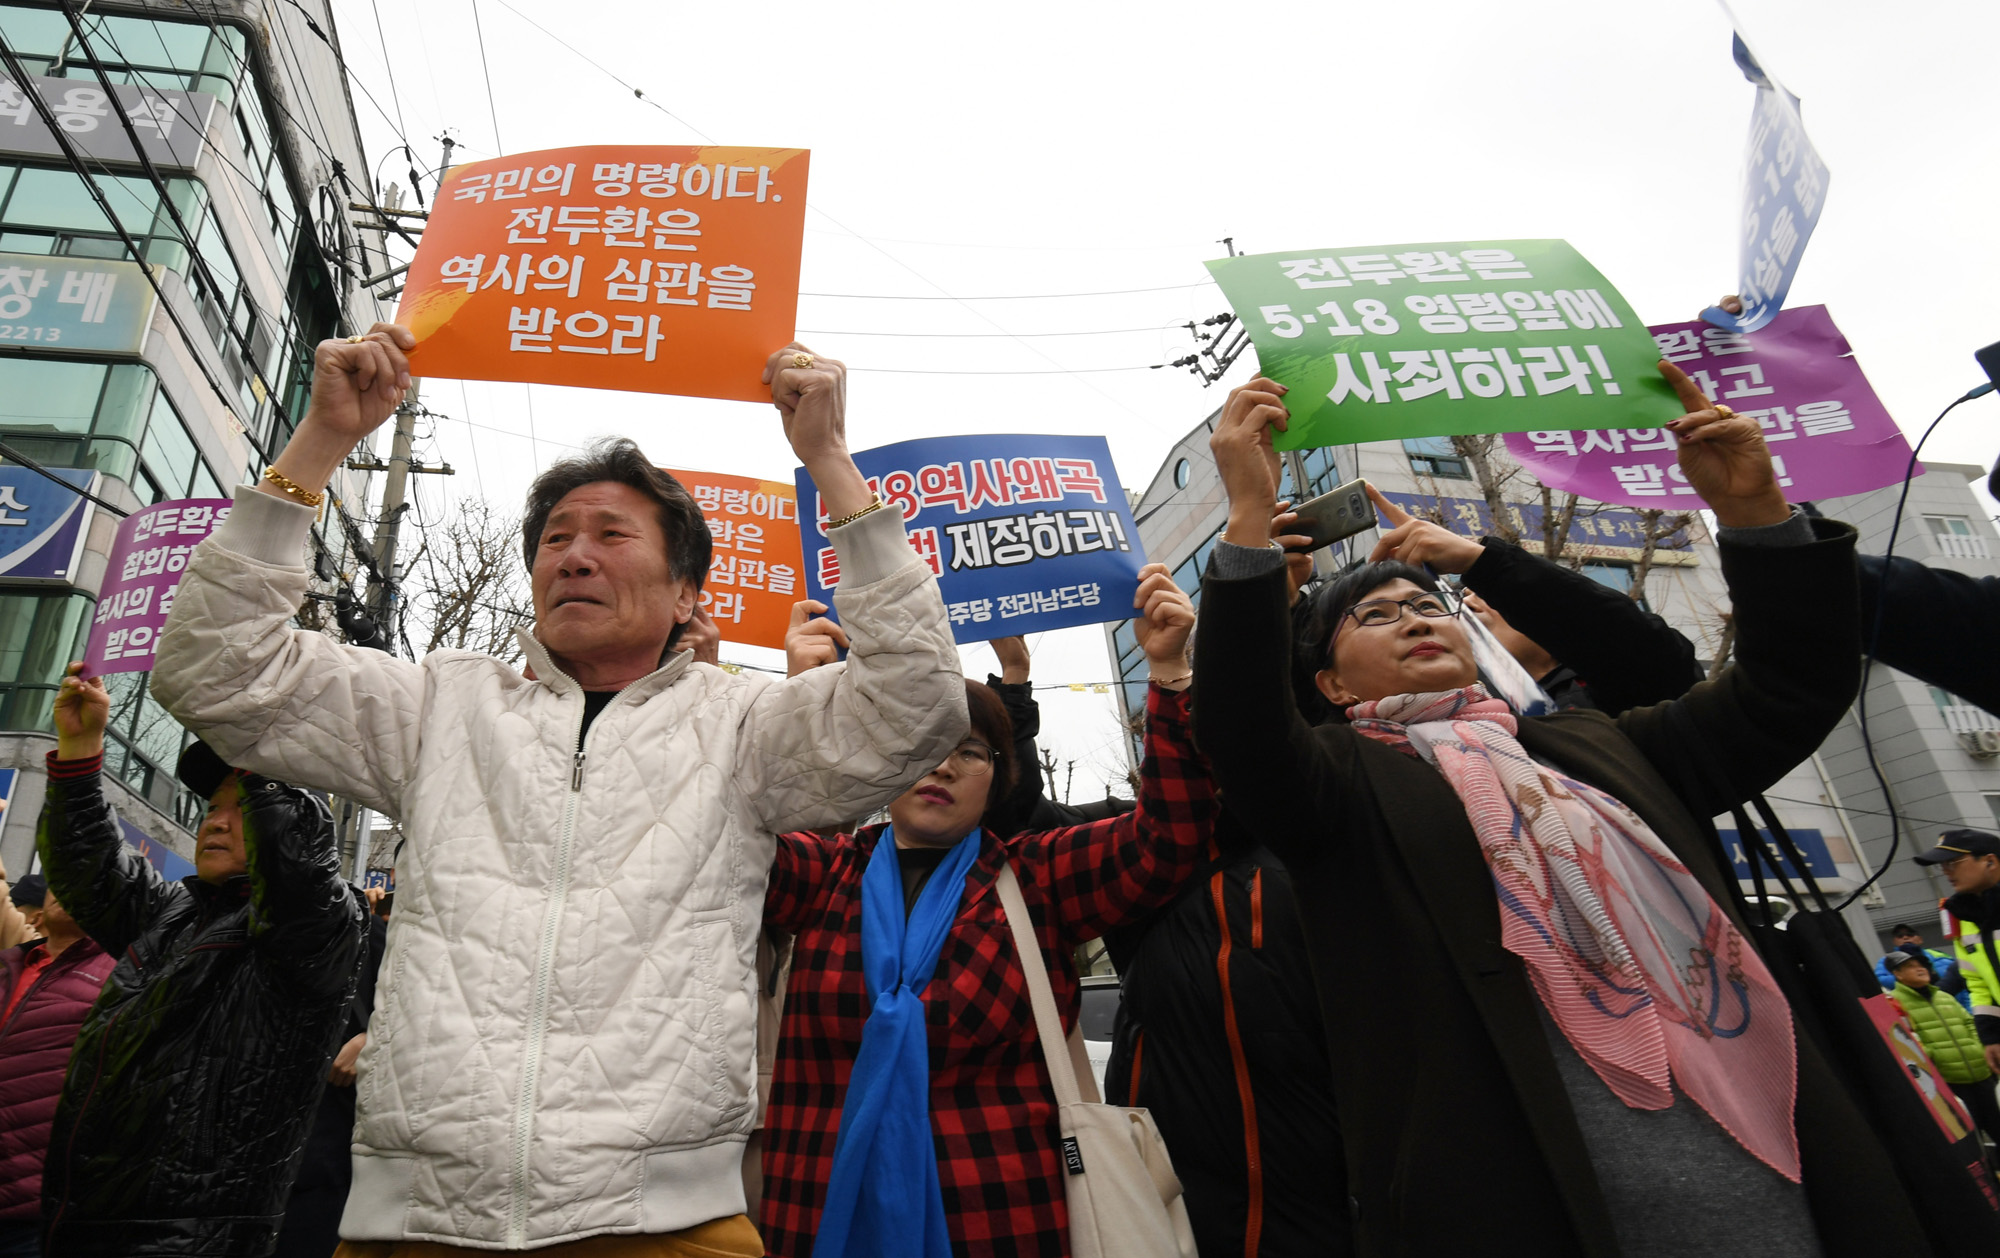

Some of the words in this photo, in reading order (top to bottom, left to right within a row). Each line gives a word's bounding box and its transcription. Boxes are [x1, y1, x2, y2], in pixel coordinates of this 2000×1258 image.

[453, 163, 576, 203] 국민의
[592, 163, 782, 203] 명령이다.
[505, 205, 702, 252] 전두환은
[440, 253, 585, 298] 역사의
[604, 258, 756, 311] 심판을
[1277, 249, 1535, 291] 전두환은
[508, 306, 665, 362] 받으라
[1259, 298, 1400, 340] 5·18
[1403, 288, 1625, 335] 영령앞에
[1327, 345, 1622, 406] 사죄하라!
[946, 510, 1131, 569] 제정하라!
[709, 554, 797, 595] 심판을
[94, 586, 155, 625] 역사의
[997, 582, 1101, 620] 전라남도당
[1063, 1141, 1082, 1169] ARTIST
